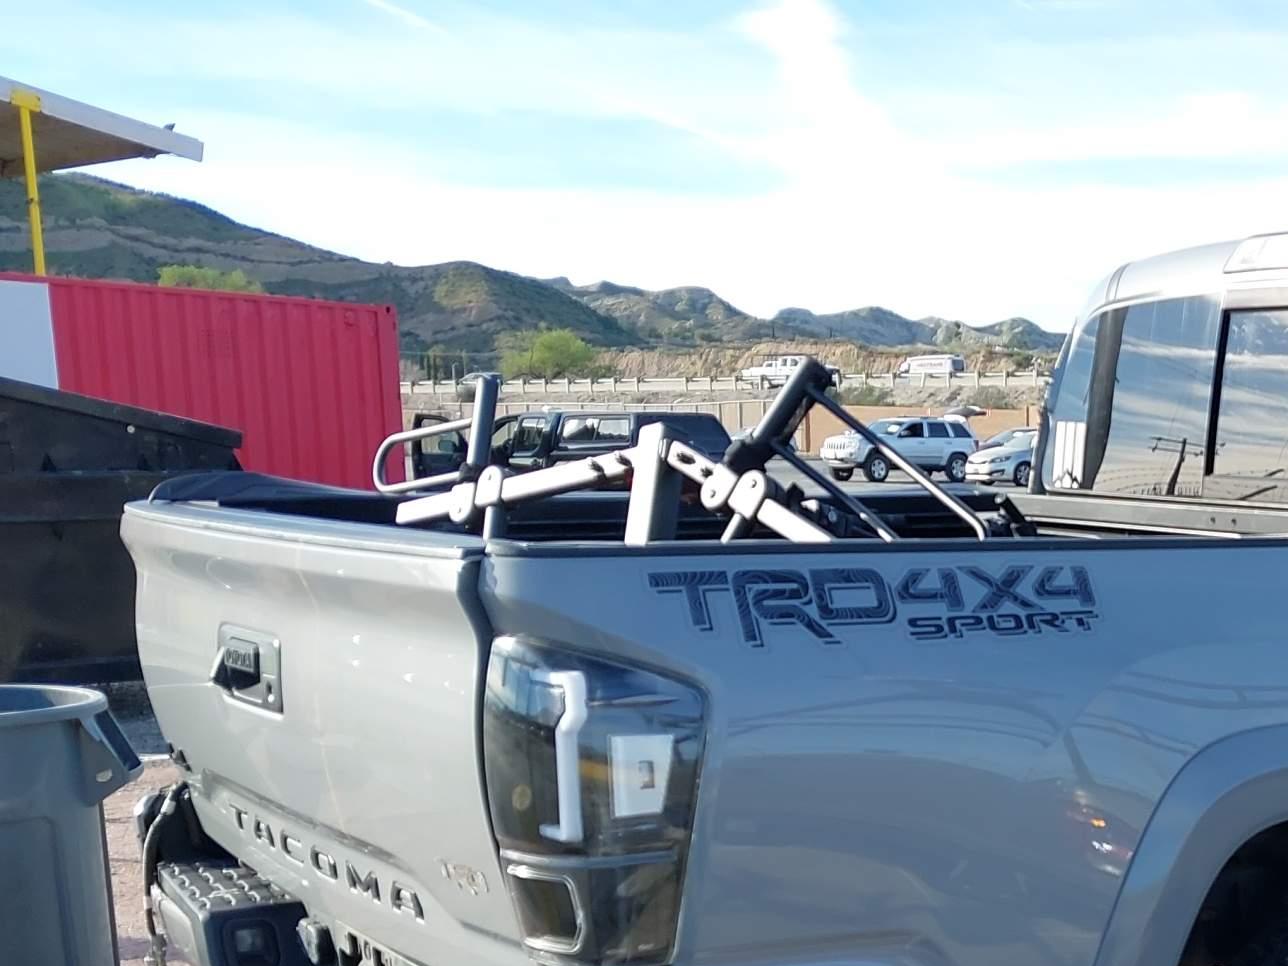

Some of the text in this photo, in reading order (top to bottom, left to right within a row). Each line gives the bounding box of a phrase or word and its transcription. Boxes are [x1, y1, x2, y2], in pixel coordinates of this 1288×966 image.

[647, 565, 1096, 648] TRD 4X4
[908, 609, 1099, 641] SPORT
[228, 802, 426, 924] TACOMA
